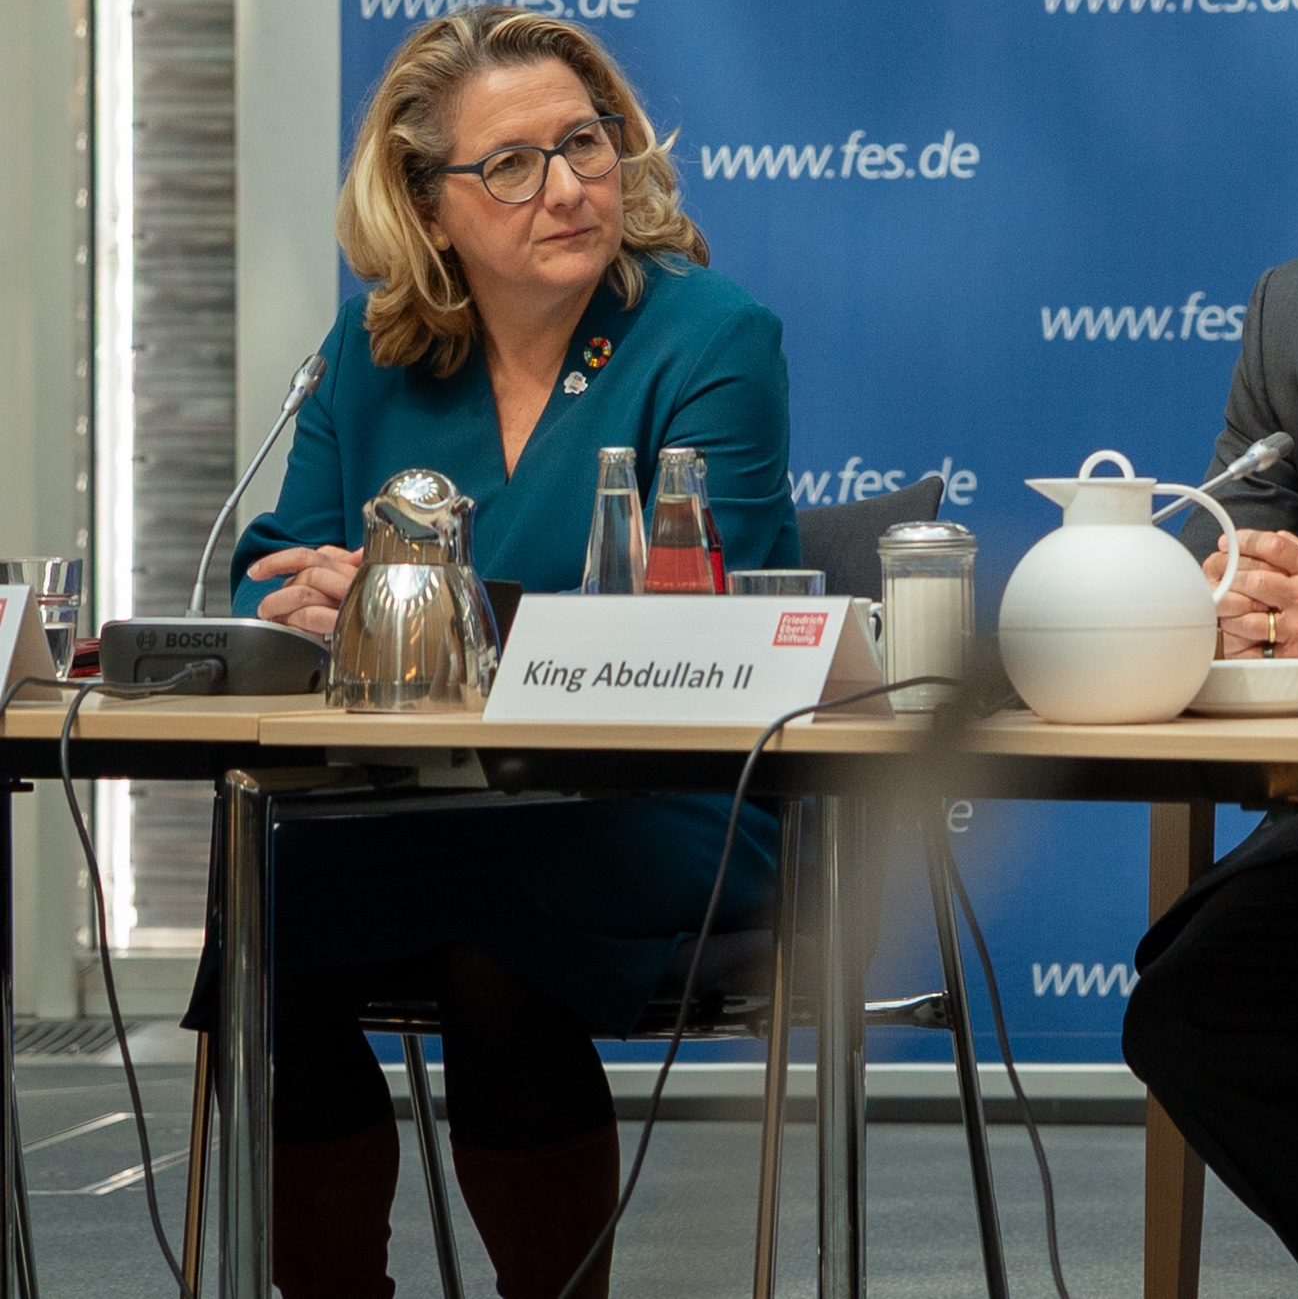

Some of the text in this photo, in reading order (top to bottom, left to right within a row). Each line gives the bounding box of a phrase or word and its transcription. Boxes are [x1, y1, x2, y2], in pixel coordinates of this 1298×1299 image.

[701, 131, 979, 179] www.fes.de
[1040, 291, 1246, 340] www.fes
[165, 632, 228, 648] BOSCH
[523, 660, 754, 693] King Abdullah II
